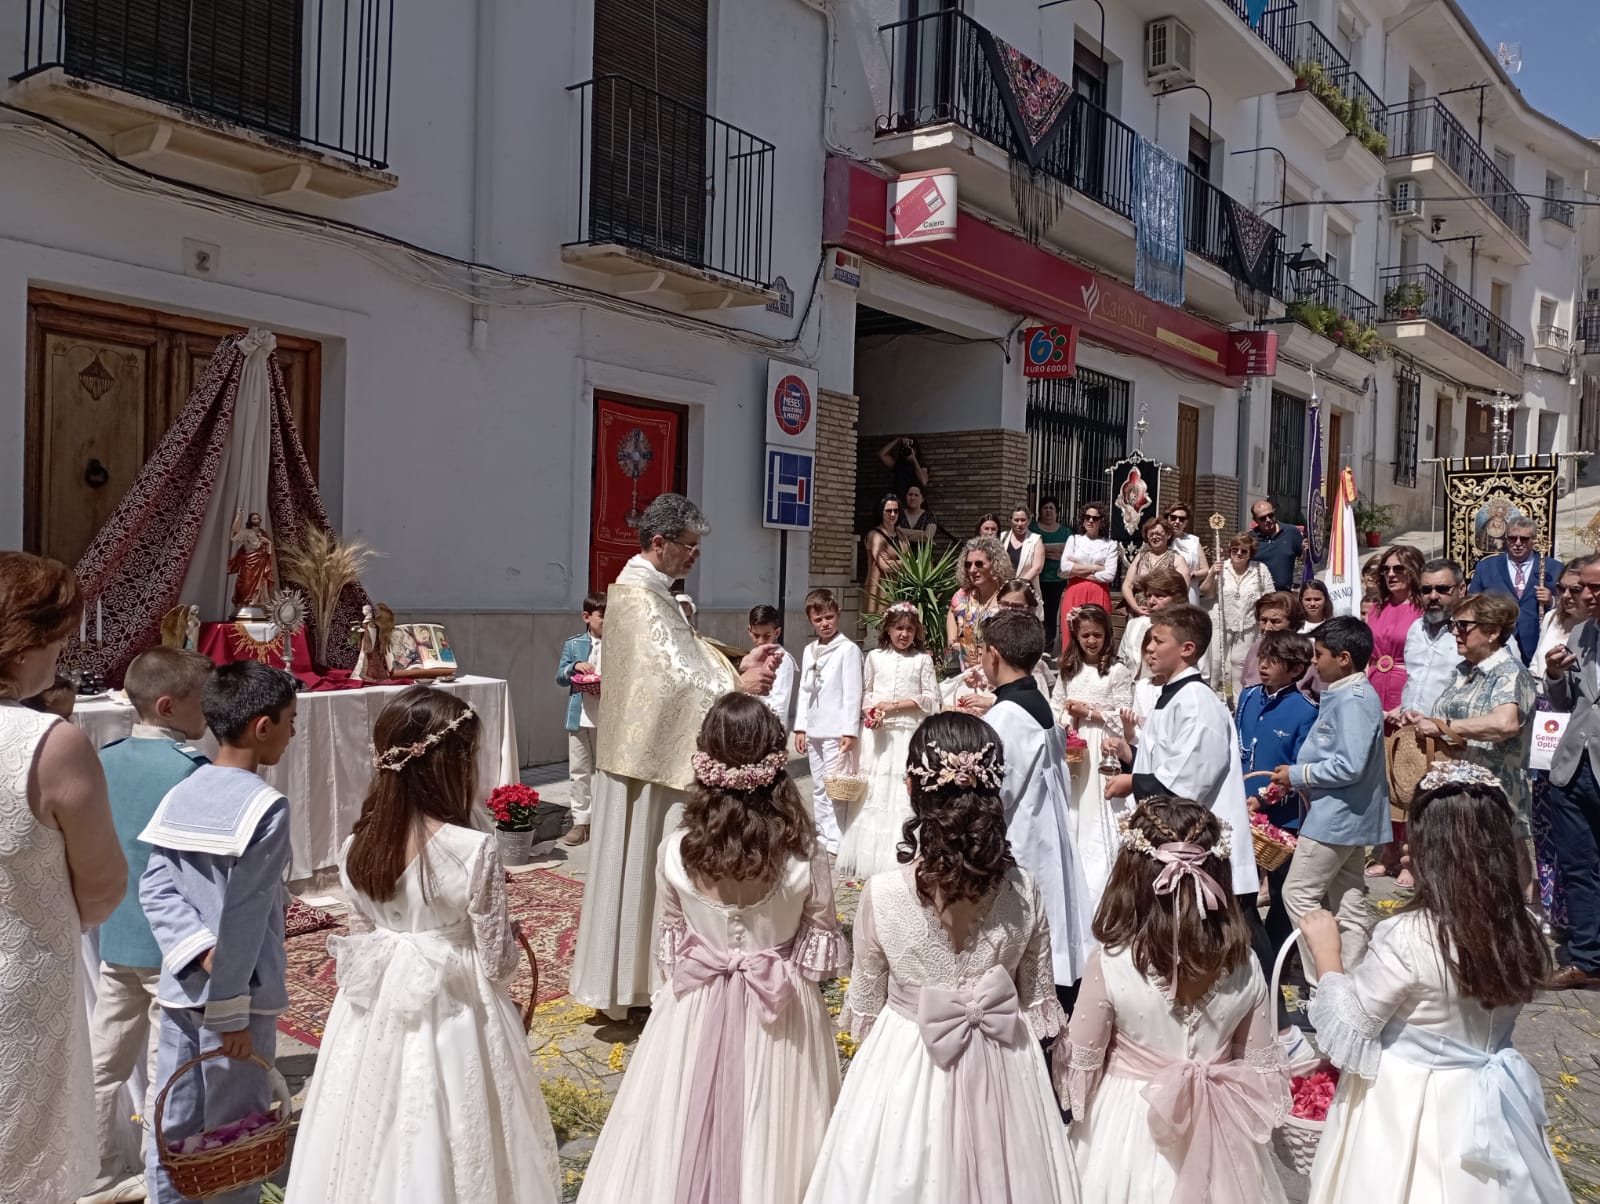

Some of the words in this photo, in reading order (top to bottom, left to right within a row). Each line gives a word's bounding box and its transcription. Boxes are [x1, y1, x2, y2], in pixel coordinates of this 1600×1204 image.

[923, 220, 945, 229] Cajero
[196, 250, 210, 272] 2
[1101, 291, 1147, 329] CajaSur
[1026, 365, 1046, 373] EURO
[1046, 364, 1067, 373] 6000
[1535, 734, 1561, 742] Genera
